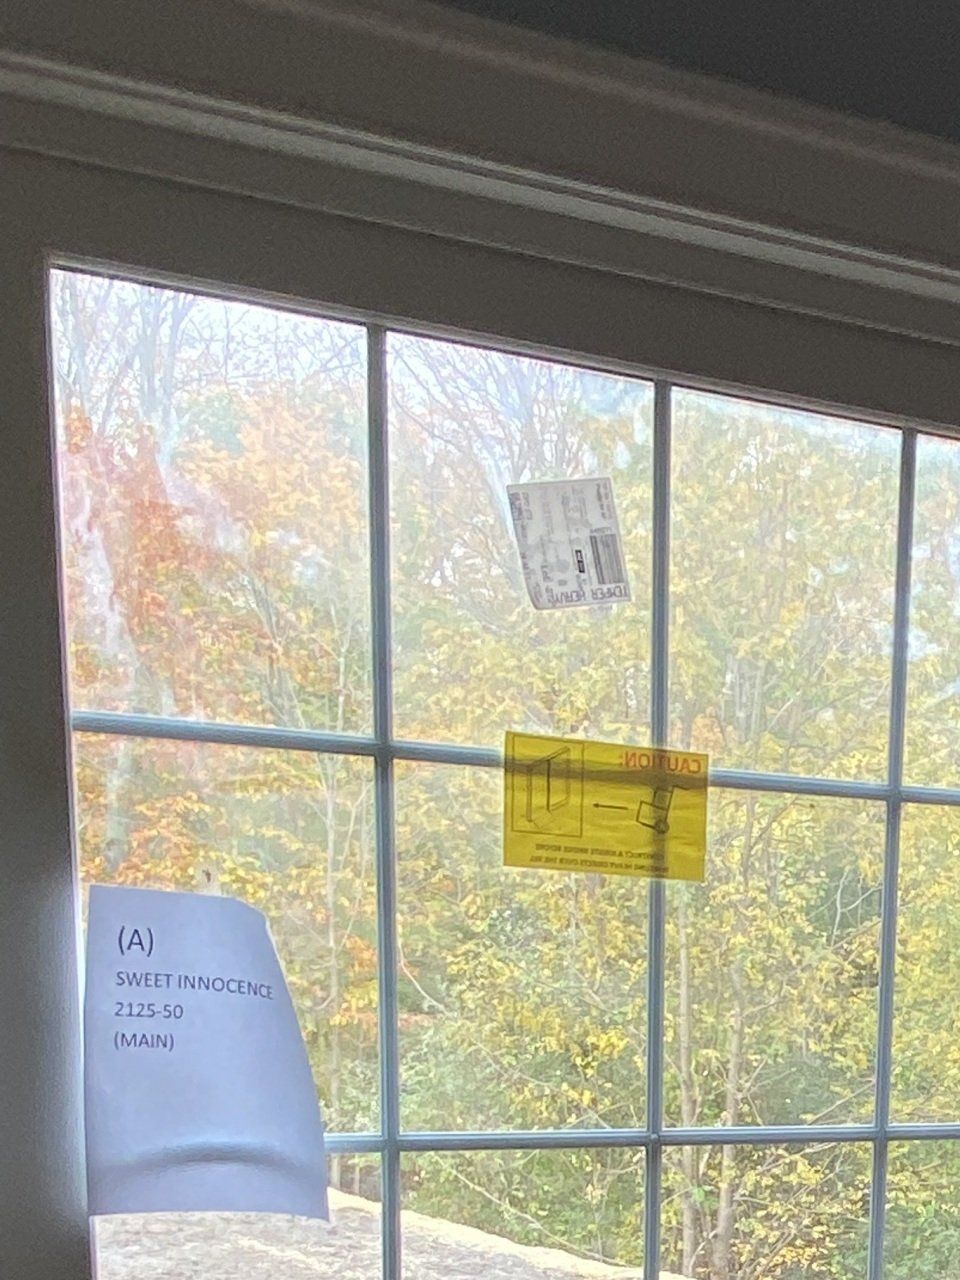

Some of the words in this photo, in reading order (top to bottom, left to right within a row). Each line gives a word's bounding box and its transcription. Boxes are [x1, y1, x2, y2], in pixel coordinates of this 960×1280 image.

[118, 924, 154, 957] (A)
[115, 971, 175, 989] SWEET
[177, 972, 274, 1000] INNOCENCE
[114, 1002, 184, 1020] 2125-50
[113, 1032, 175, 1052] (MAIN)
